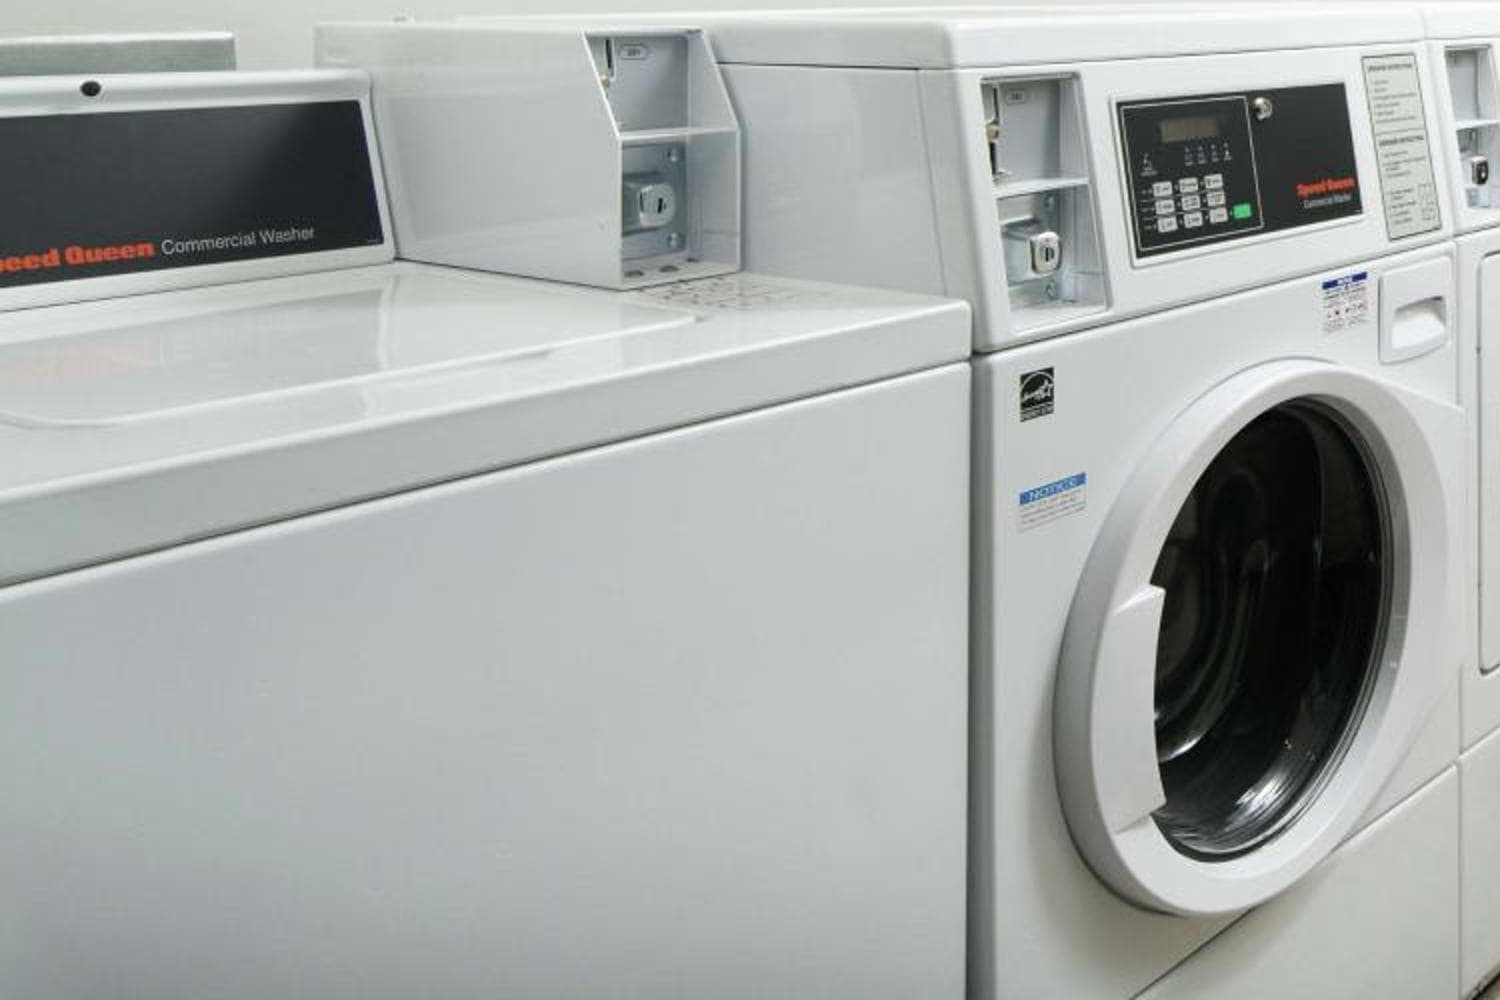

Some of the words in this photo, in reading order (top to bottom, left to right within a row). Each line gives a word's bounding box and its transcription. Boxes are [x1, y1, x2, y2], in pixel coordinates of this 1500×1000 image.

[0, 248, 60, 272] eed
[65, 241, 155, 265] Queen
[161, 231, 256, 255] Commercial
[259, 226, 314, 245] Washer
